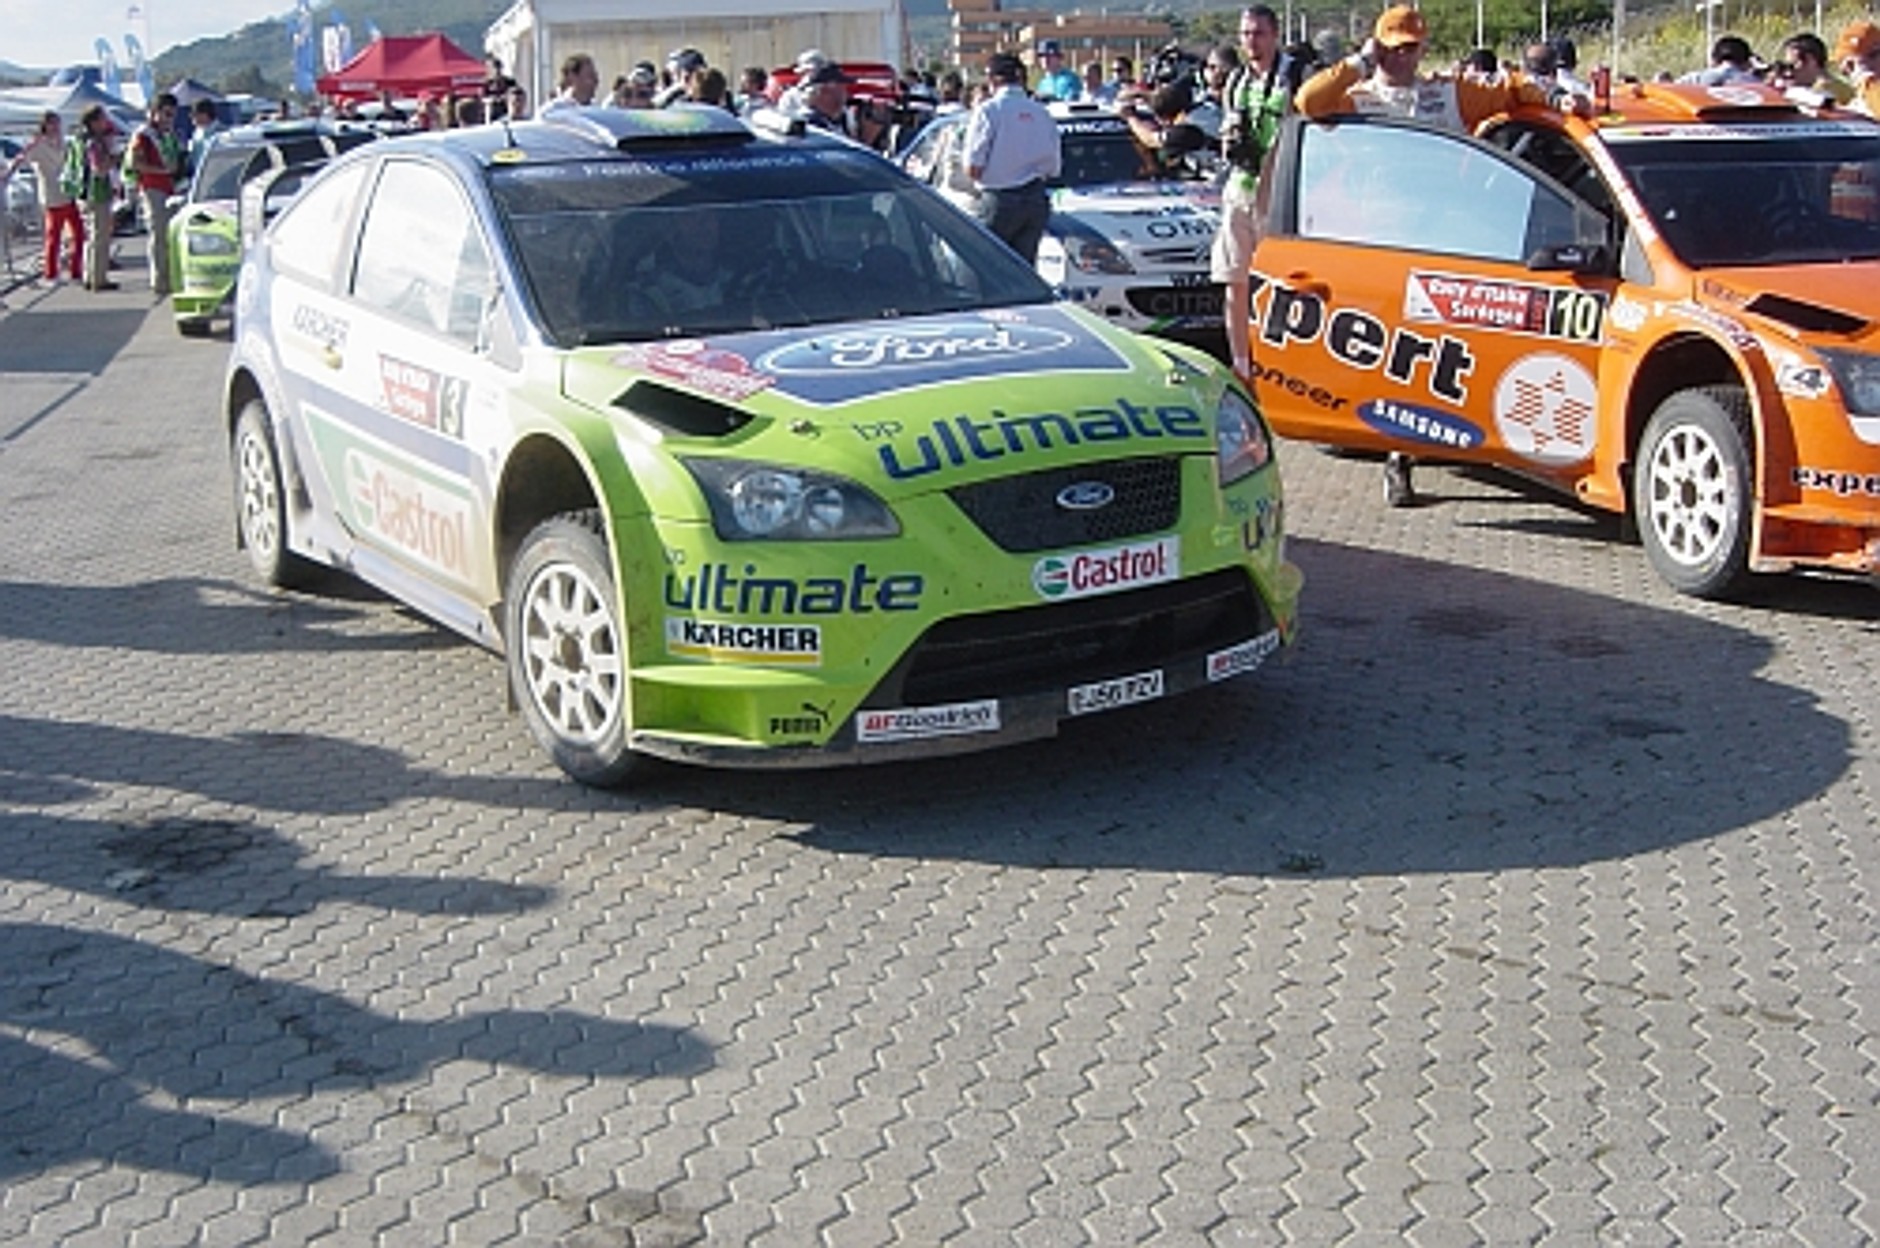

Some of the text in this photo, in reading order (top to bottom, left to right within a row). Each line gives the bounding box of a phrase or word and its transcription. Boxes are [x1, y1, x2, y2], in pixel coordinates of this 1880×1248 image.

[1557, 293, 1597, 338] 10
[831, 324, 1029, 367] Ford
[853, 420, 902, 441] bp
[878, 399, 1207, 480] ultimate
[372, 471, 472, 582] Castrol
[664, 563, 924, 615] ultimate
[1070, 542, 1167, 591] Castrol
